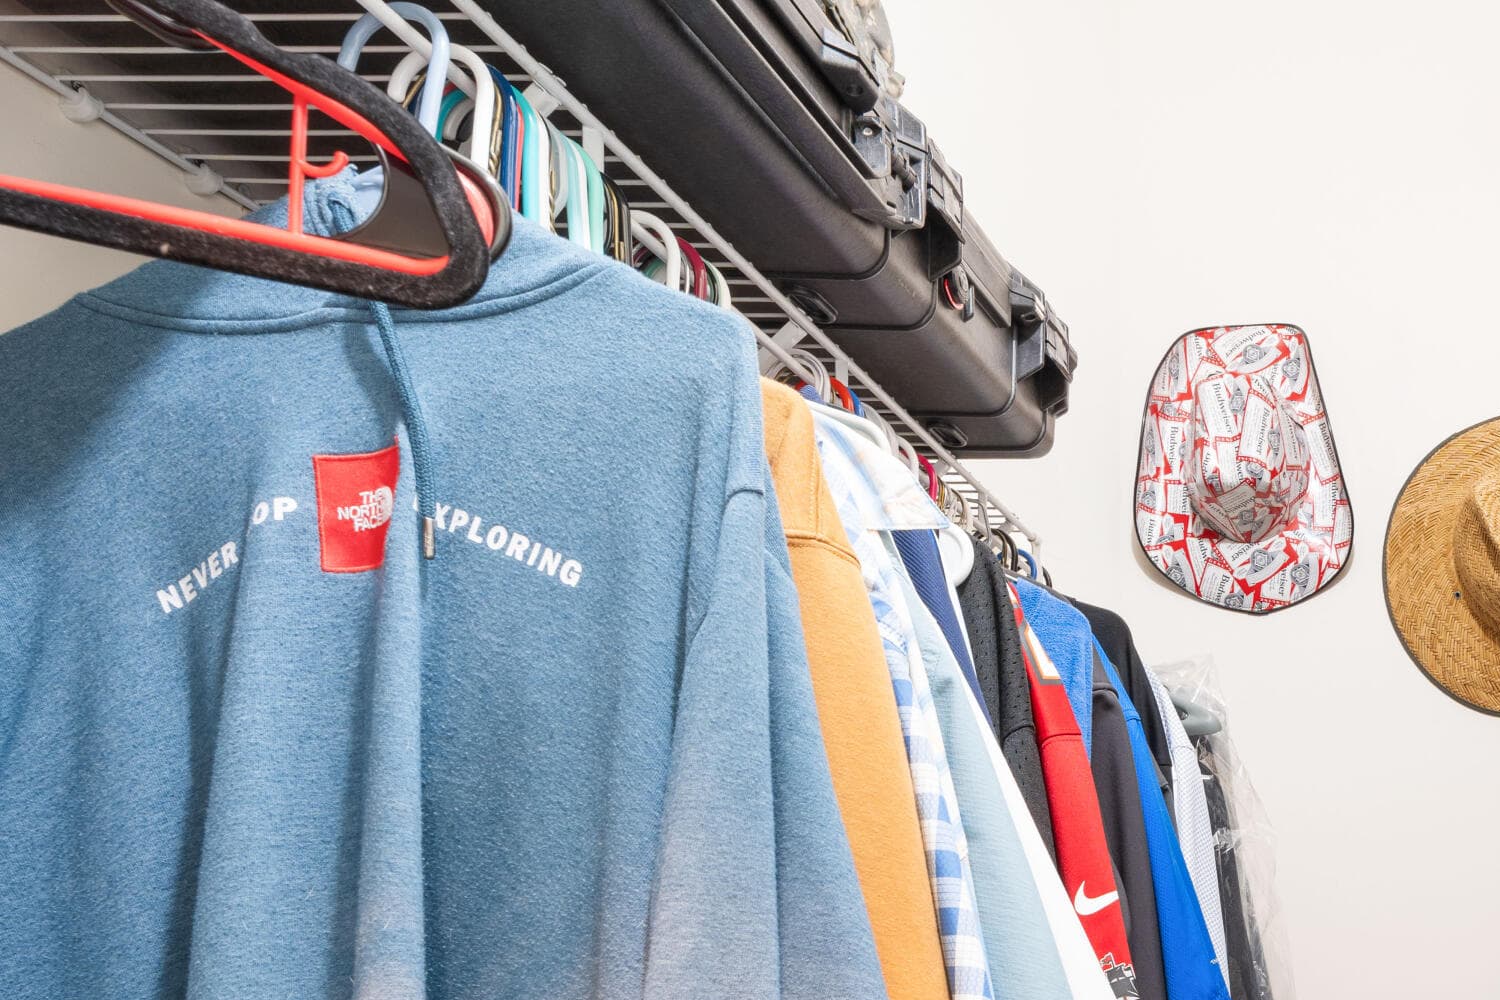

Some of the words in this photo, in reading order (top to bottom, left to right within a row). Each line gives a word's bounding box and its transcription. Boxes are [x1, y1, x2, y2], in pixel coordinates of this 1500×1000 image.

[359, 488, 386, 505] THE
[337, 503, 384, 521] NORTH
[354, 515, 384, 532] FACE
[156, 541, 239, 614] NEVER
[251, 496, 298, 526] OP
[412, 495, 583, 588] XPLORING
